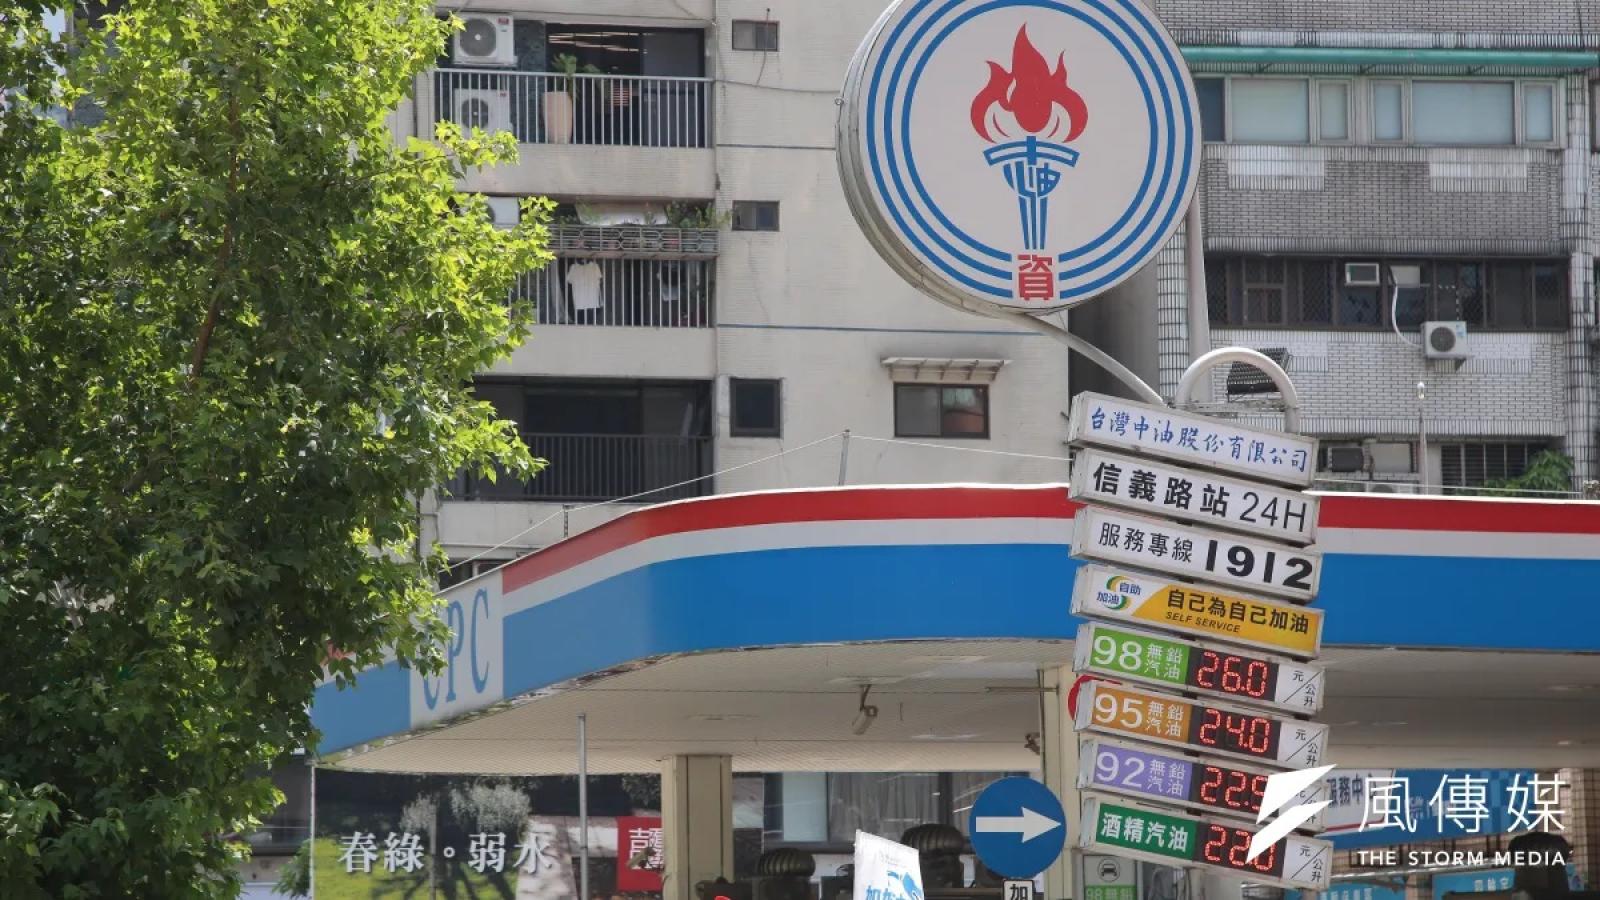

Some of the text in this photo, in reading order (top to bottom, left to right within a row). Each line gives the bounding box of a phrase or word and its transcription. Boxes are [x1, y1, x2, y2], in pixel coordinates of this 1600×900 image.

[1018, 254, 1054, 300] 資
[1091, 407, 1308, 473] 台灣中油股份有限公司
[1092, 461, 1307, 533] 信義路站 24H
[1098, 522, 1314, 592] 服務專線 1912
[1096, 592, 1120, 605] 加油
[1119, 581, 1142, 596] 自助
[1165, 611, 1241, 634] SELF SERVICE
[1166, 589, 1309, 635] 自己為自己加油
[1093, 635, 1143, 671] 98
[1144, 659, 1181, 679] 汽油
[1147, 643, 1183, 665] 無鉛
[1197, 651, 1269, 697] 26.0
[1094, 694, 1143, 728] 95
[1146, 717, 1181, 737] 汽油
[1148, 700, 1184, 722] 無鉛
[1199, 708, 1270, 753] 24.0
[1096, 751, 1145, 788] 92
[1147, 775, 1183, 796] 汽油
[1149, 759, 1186, 780] 無鉛
[1101, 812, 1189, 853] 酒精汽油
